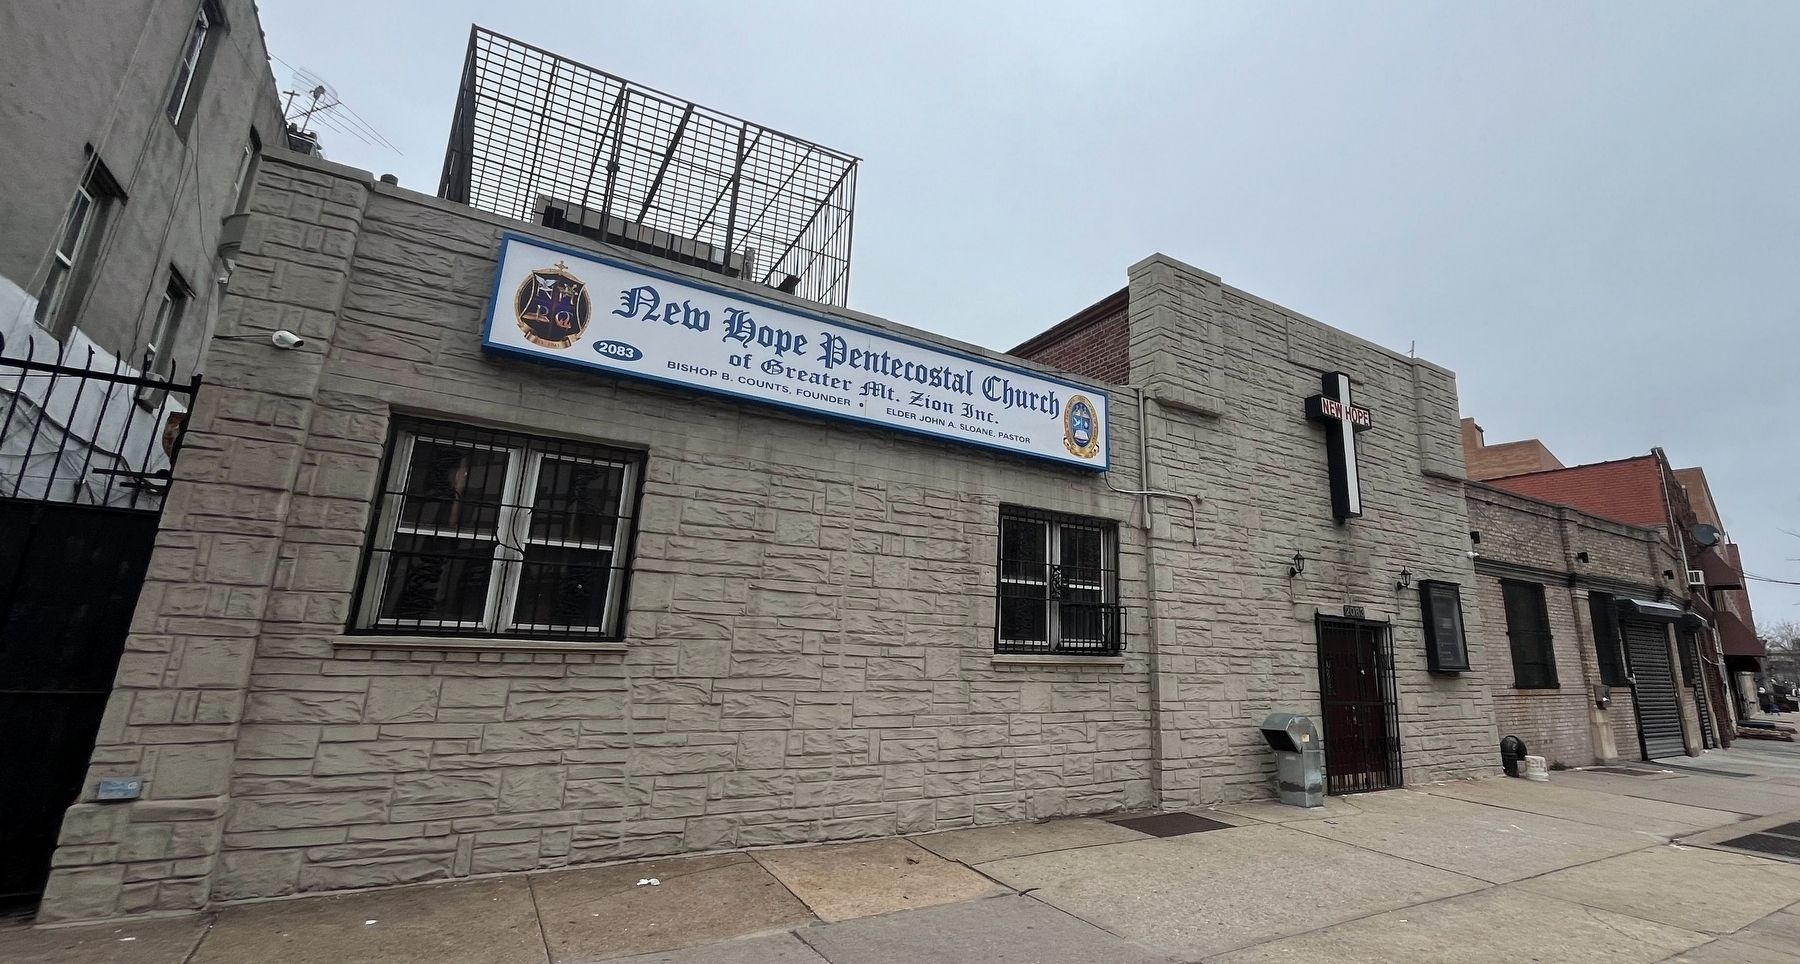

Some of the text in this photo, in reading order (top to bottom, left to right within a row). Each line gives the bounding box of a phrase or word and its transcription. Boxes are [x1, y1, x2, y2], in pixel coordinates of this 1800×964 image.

[598, 341, 634, 359] 2083
[612, 286, 711, 332] New
[722, 307, 809, 358] Hope
[816, 331, 973, 396] Pentecostal
[982, 375, 1060, 420] Church
[667, 360, 718, 378] BISHOP
[721, 372, 734, 382] B.
[796, 388, 851, 406] FOUNDER
[728, 353, 999, 425] of Greater Mt. Zion Inc.
[886, 407, 1031, 444] ELDER JOHN A. SLOANE, PASTOR
[1322, 399, 1369, 425] NEW HOPE
